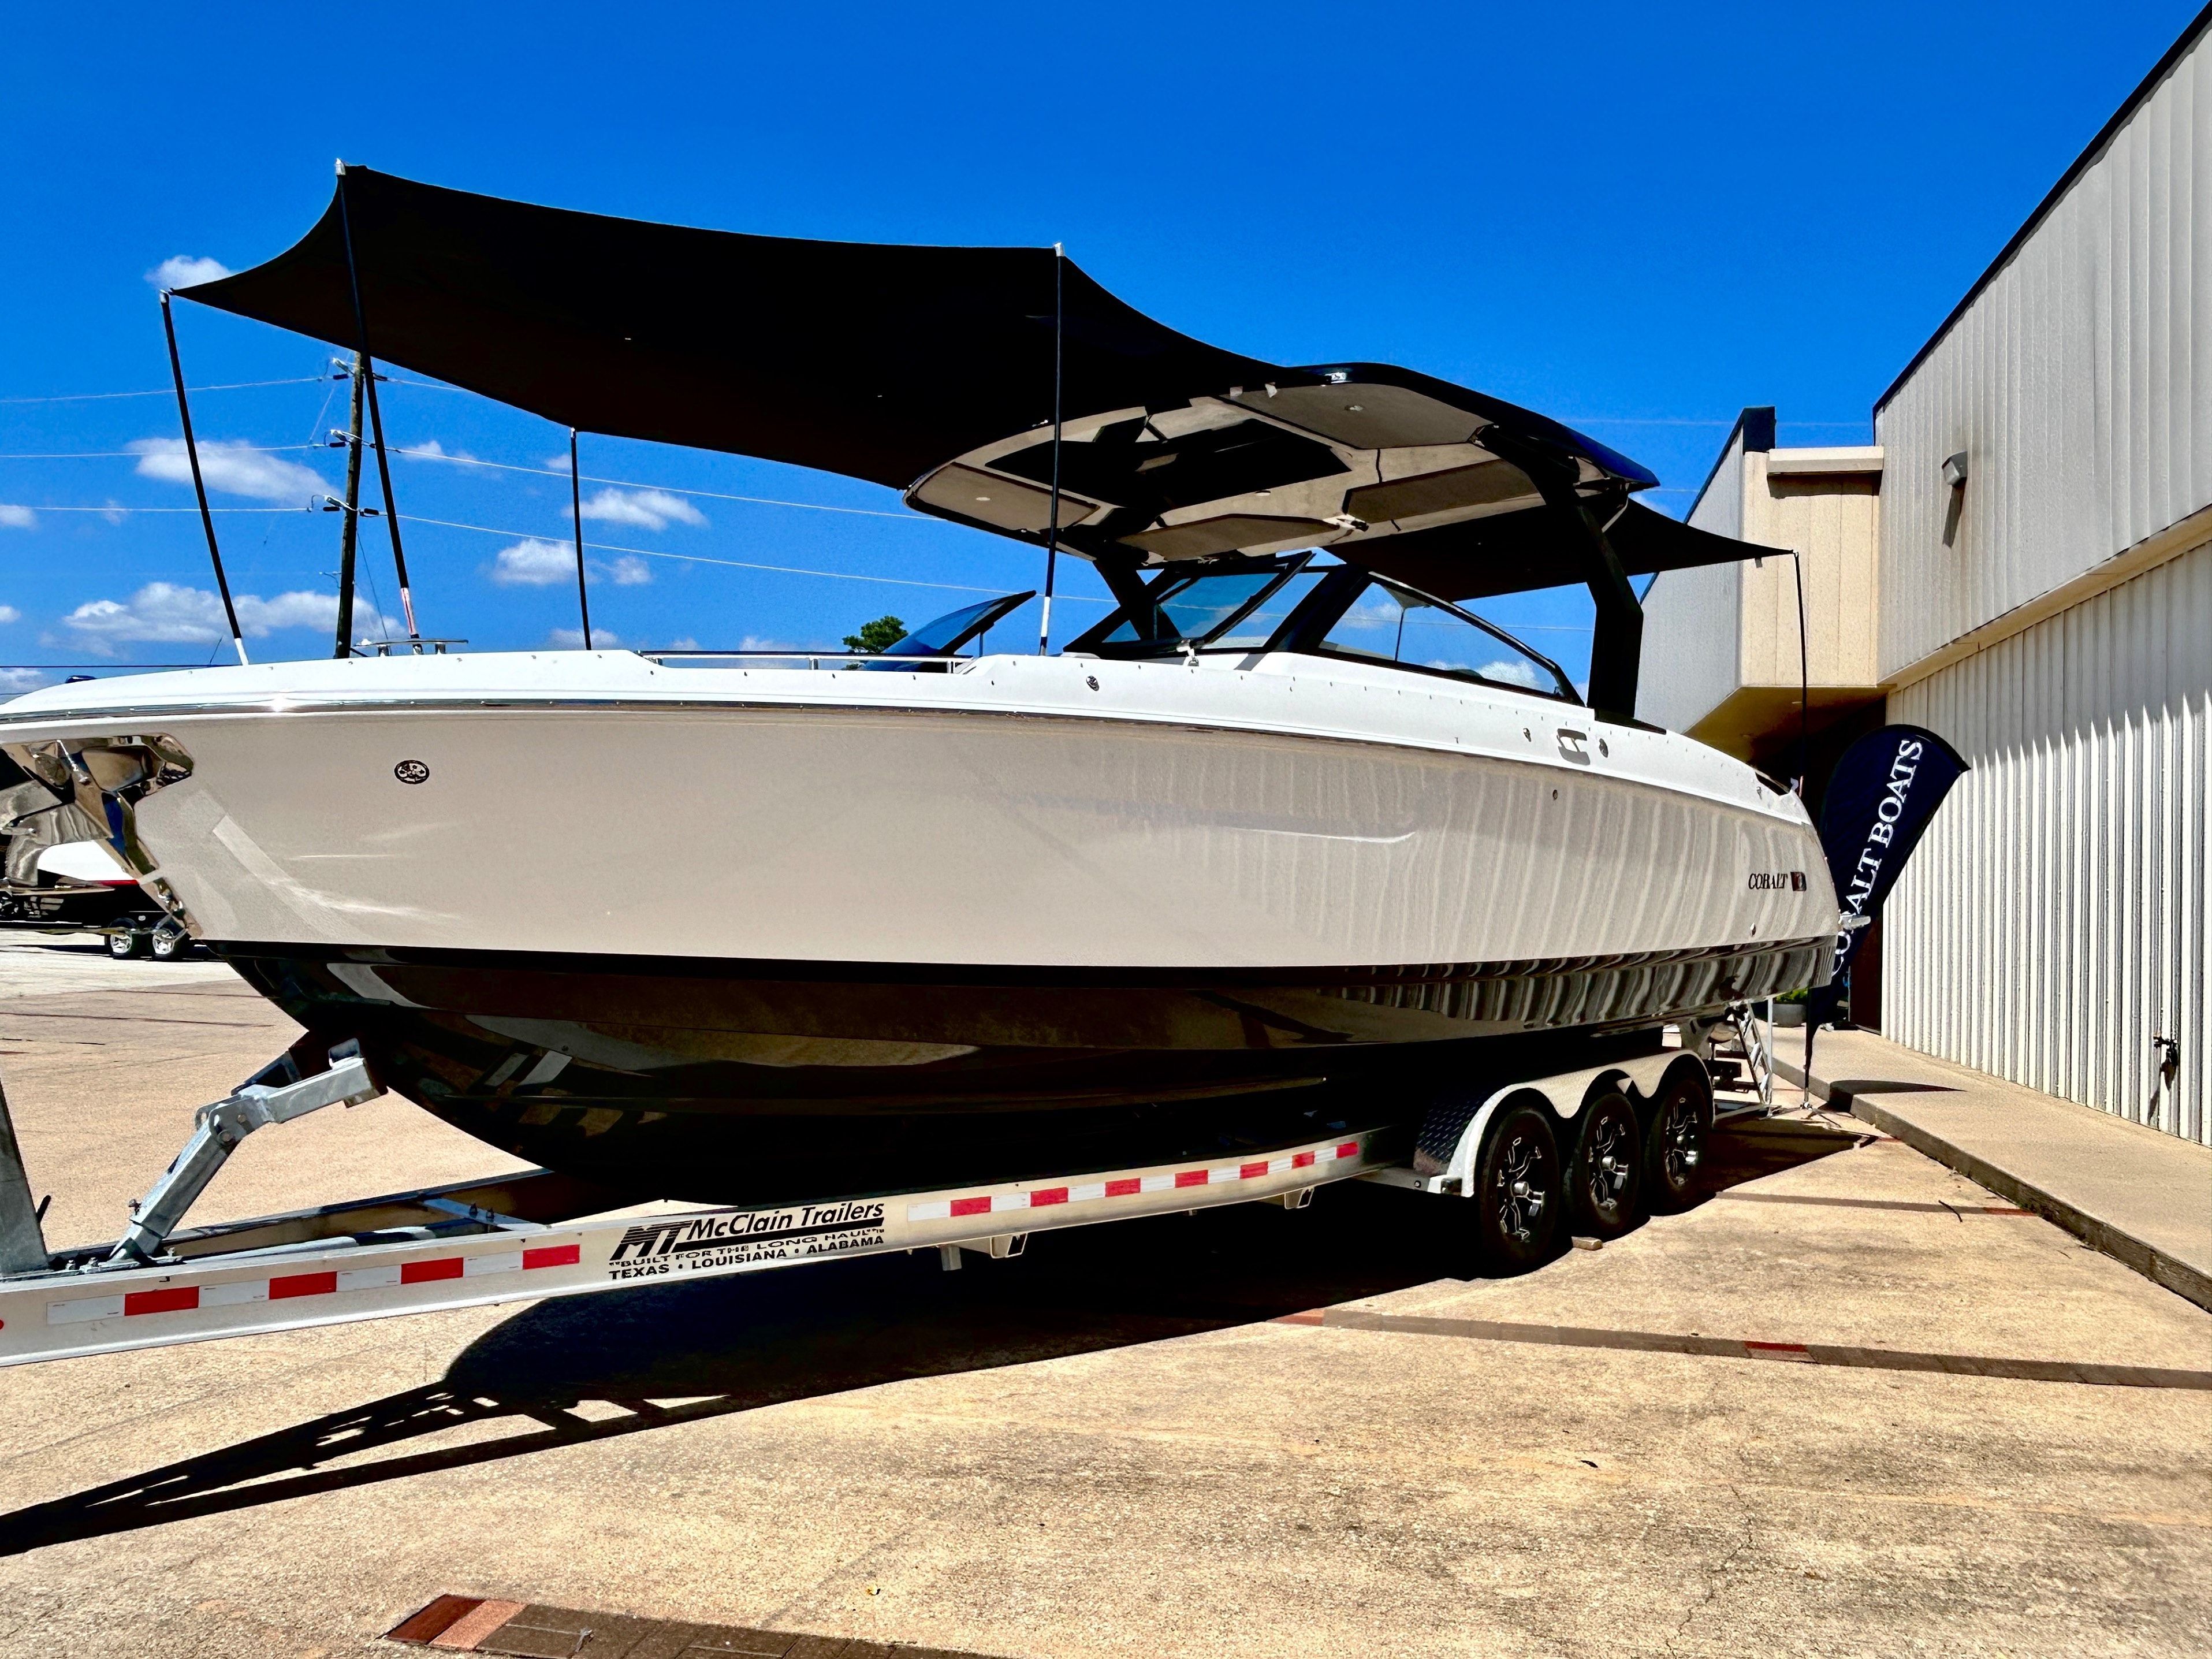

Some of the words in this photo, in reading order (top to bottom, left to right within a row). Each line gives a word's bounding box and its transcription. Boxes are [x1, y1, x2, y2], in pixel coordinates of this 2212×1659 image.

[1867, 740, 1923, 848] BOATS
[1748, 873, 1788, 889] COBALT
[687, 1211, 792, 1240] McClain
[801, 1203, 884, 1226] Trailers
[609, 1264, 669, 1279] TEXAS
[692, 1249, 787, 1269] LOUISIANA
[806, 1236, 884, 1254] ALABAMA
[676, 1251, 712, 1260] FOR
[717, 1245, 748, 1255] THE
[757, 1237, 817, 1249] LONG
